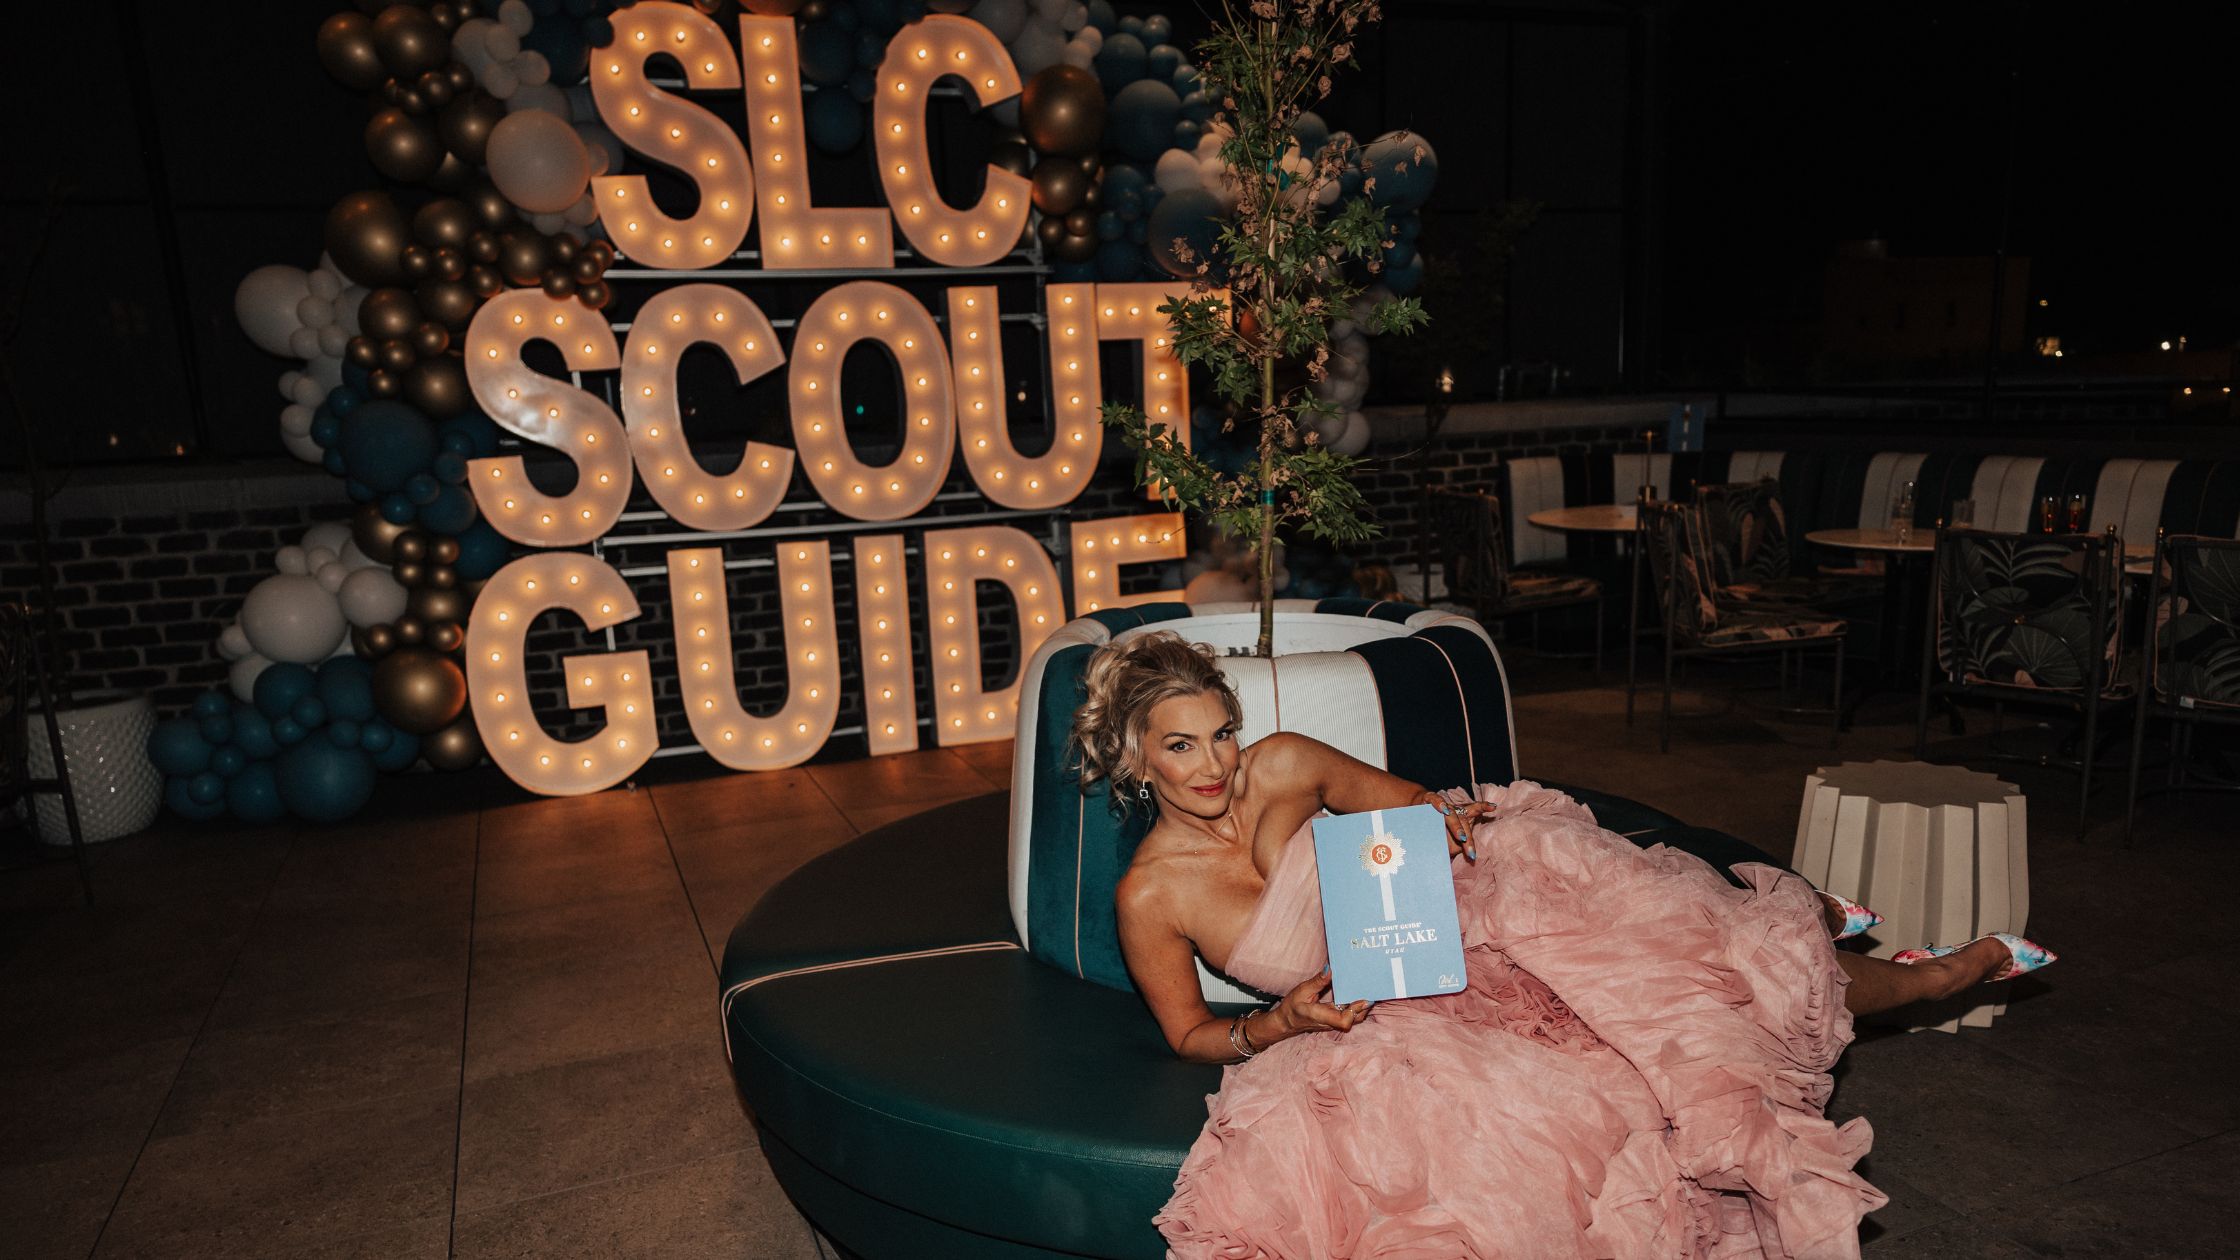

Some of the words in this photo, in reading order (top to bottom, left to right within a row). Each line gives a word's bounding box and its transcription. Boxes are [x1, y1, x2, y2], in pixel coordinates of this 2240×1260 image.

[591, 1, 1032, 269] SLC
[464, 280, 1231, 547] SCOUT
[1395, 929, 1437, 945] LAKE
